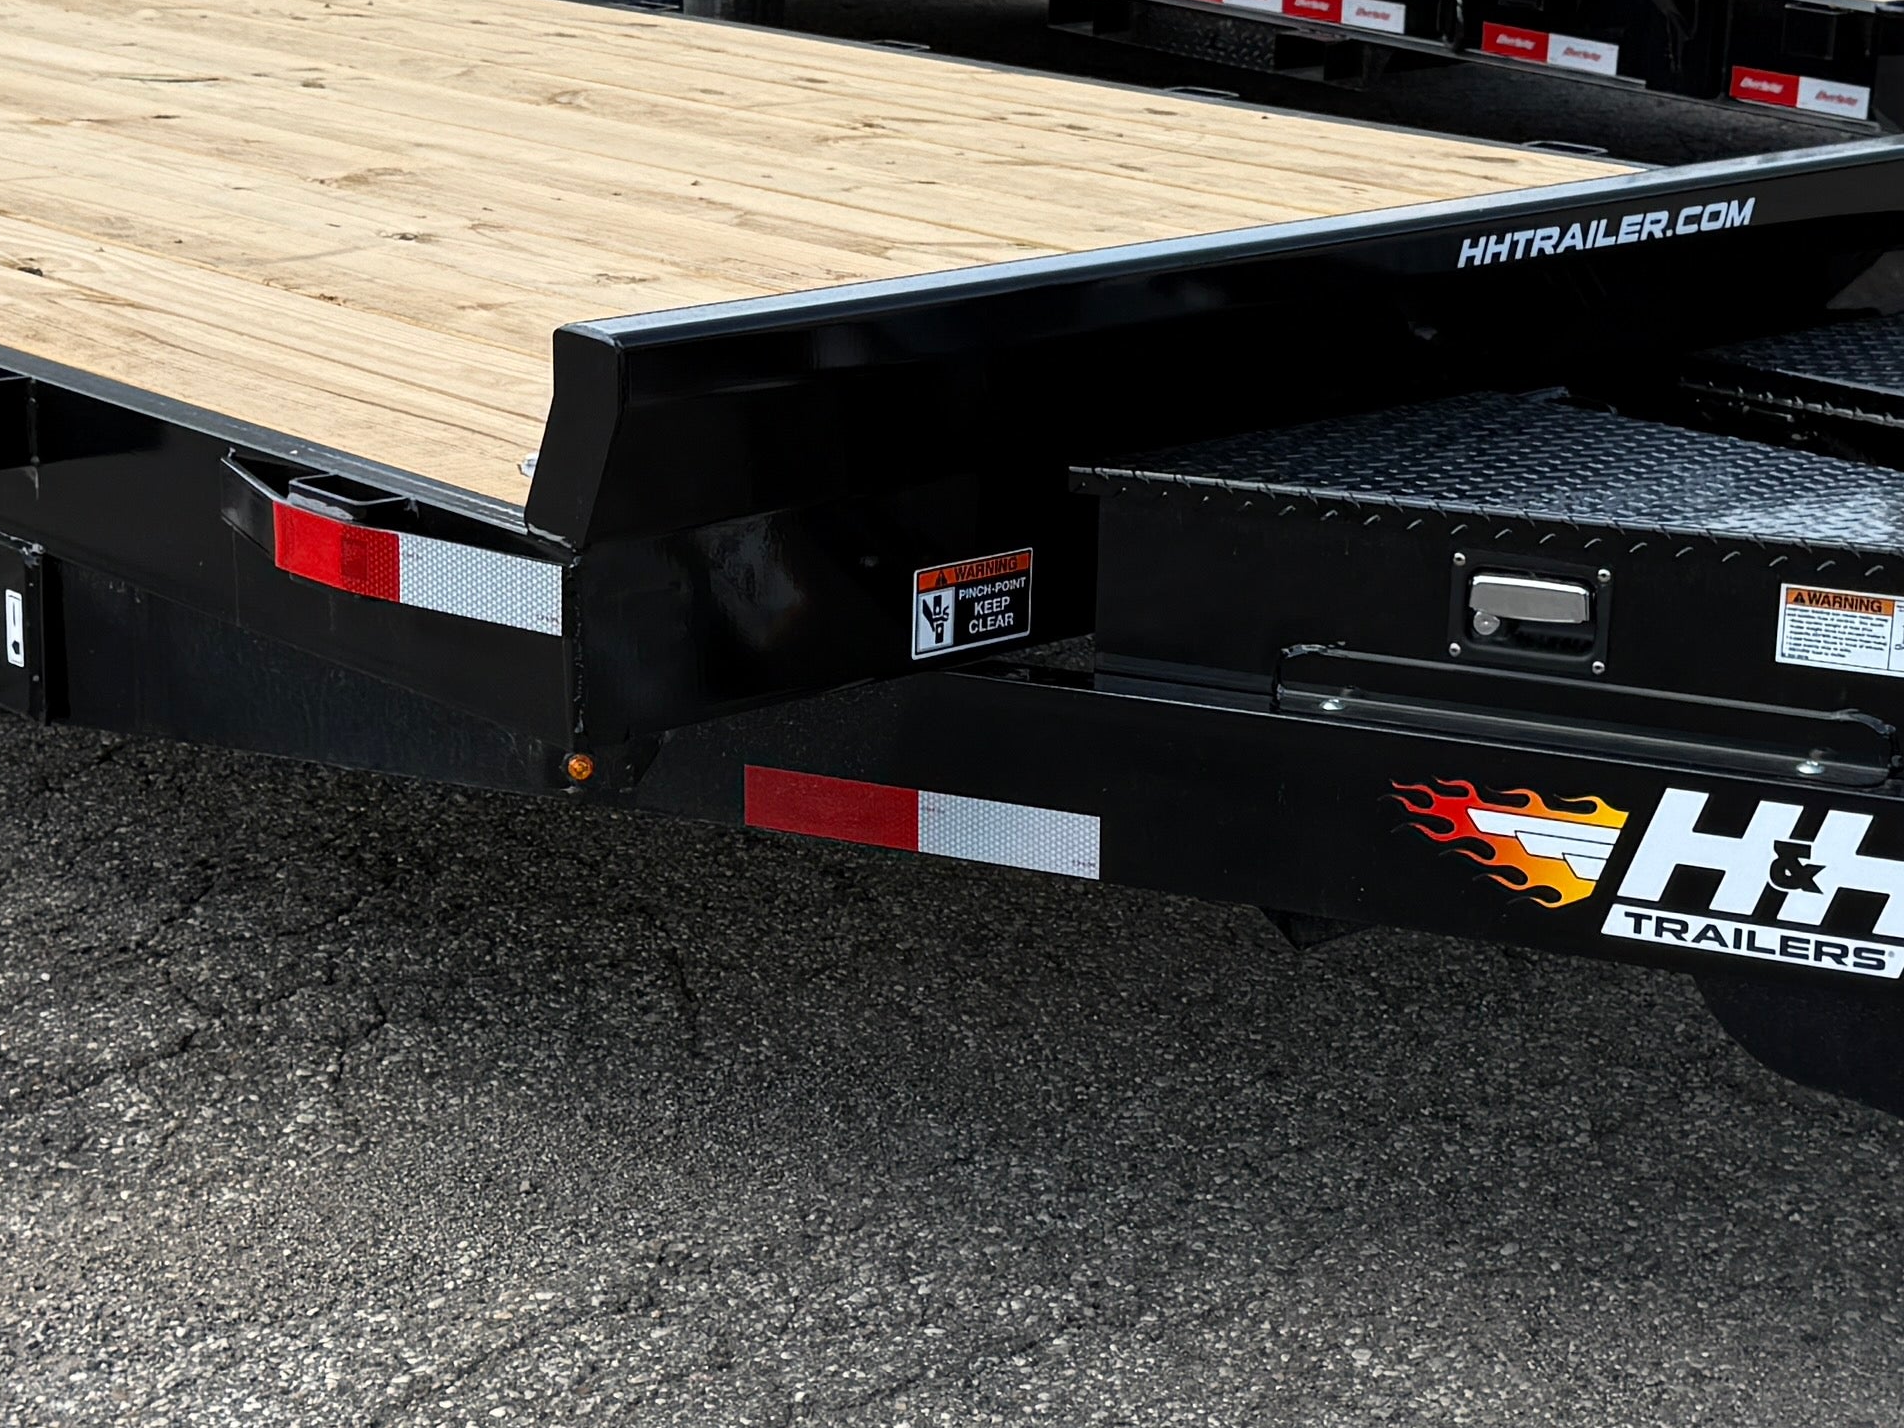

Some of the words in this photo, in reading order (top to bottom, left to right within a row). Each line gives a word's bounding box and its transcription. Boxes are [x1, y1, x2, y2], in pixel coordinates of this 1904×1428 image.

[1457, 197, 1756, 269] HHTRAILER.COM
[955, 556, 1018, 582] WARNING
[959, 577, 1026, 600] PINCH-POINT
[975, 596, 1010, 616] KEEP
[1807, 592, 1883, 613] WARNING
[968, 612, 1014, 634] CLEAR
[1624, 911, 1886, 971] TRAILERS
